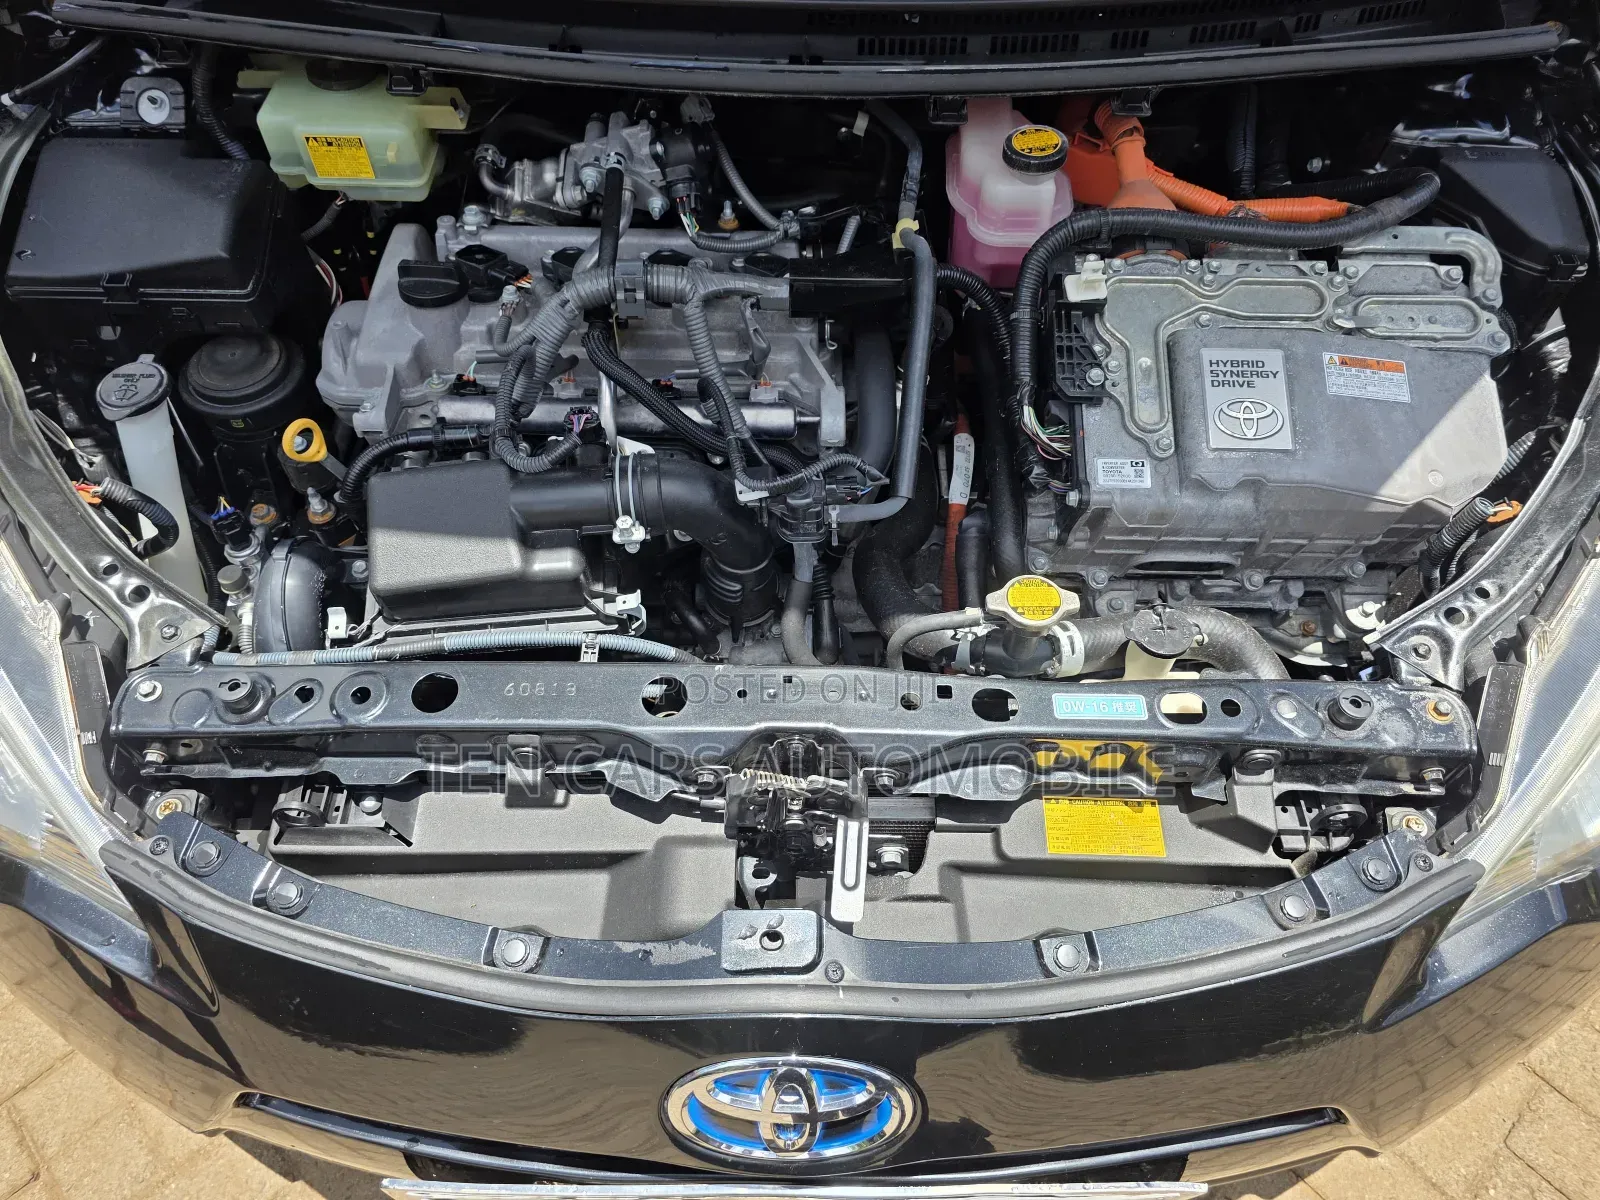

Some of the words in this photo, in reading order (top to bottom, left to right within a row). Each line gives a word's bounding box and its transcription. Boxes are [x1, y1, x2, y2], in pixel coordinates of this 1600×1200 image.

[1209, 360, 1265, 368] HYBRID
[1210, 370, 1279, 378] SYNERGY
[1211, 380, 1256, 388] DRIVE
[1062, 700, 1109, 713] 0W-16
